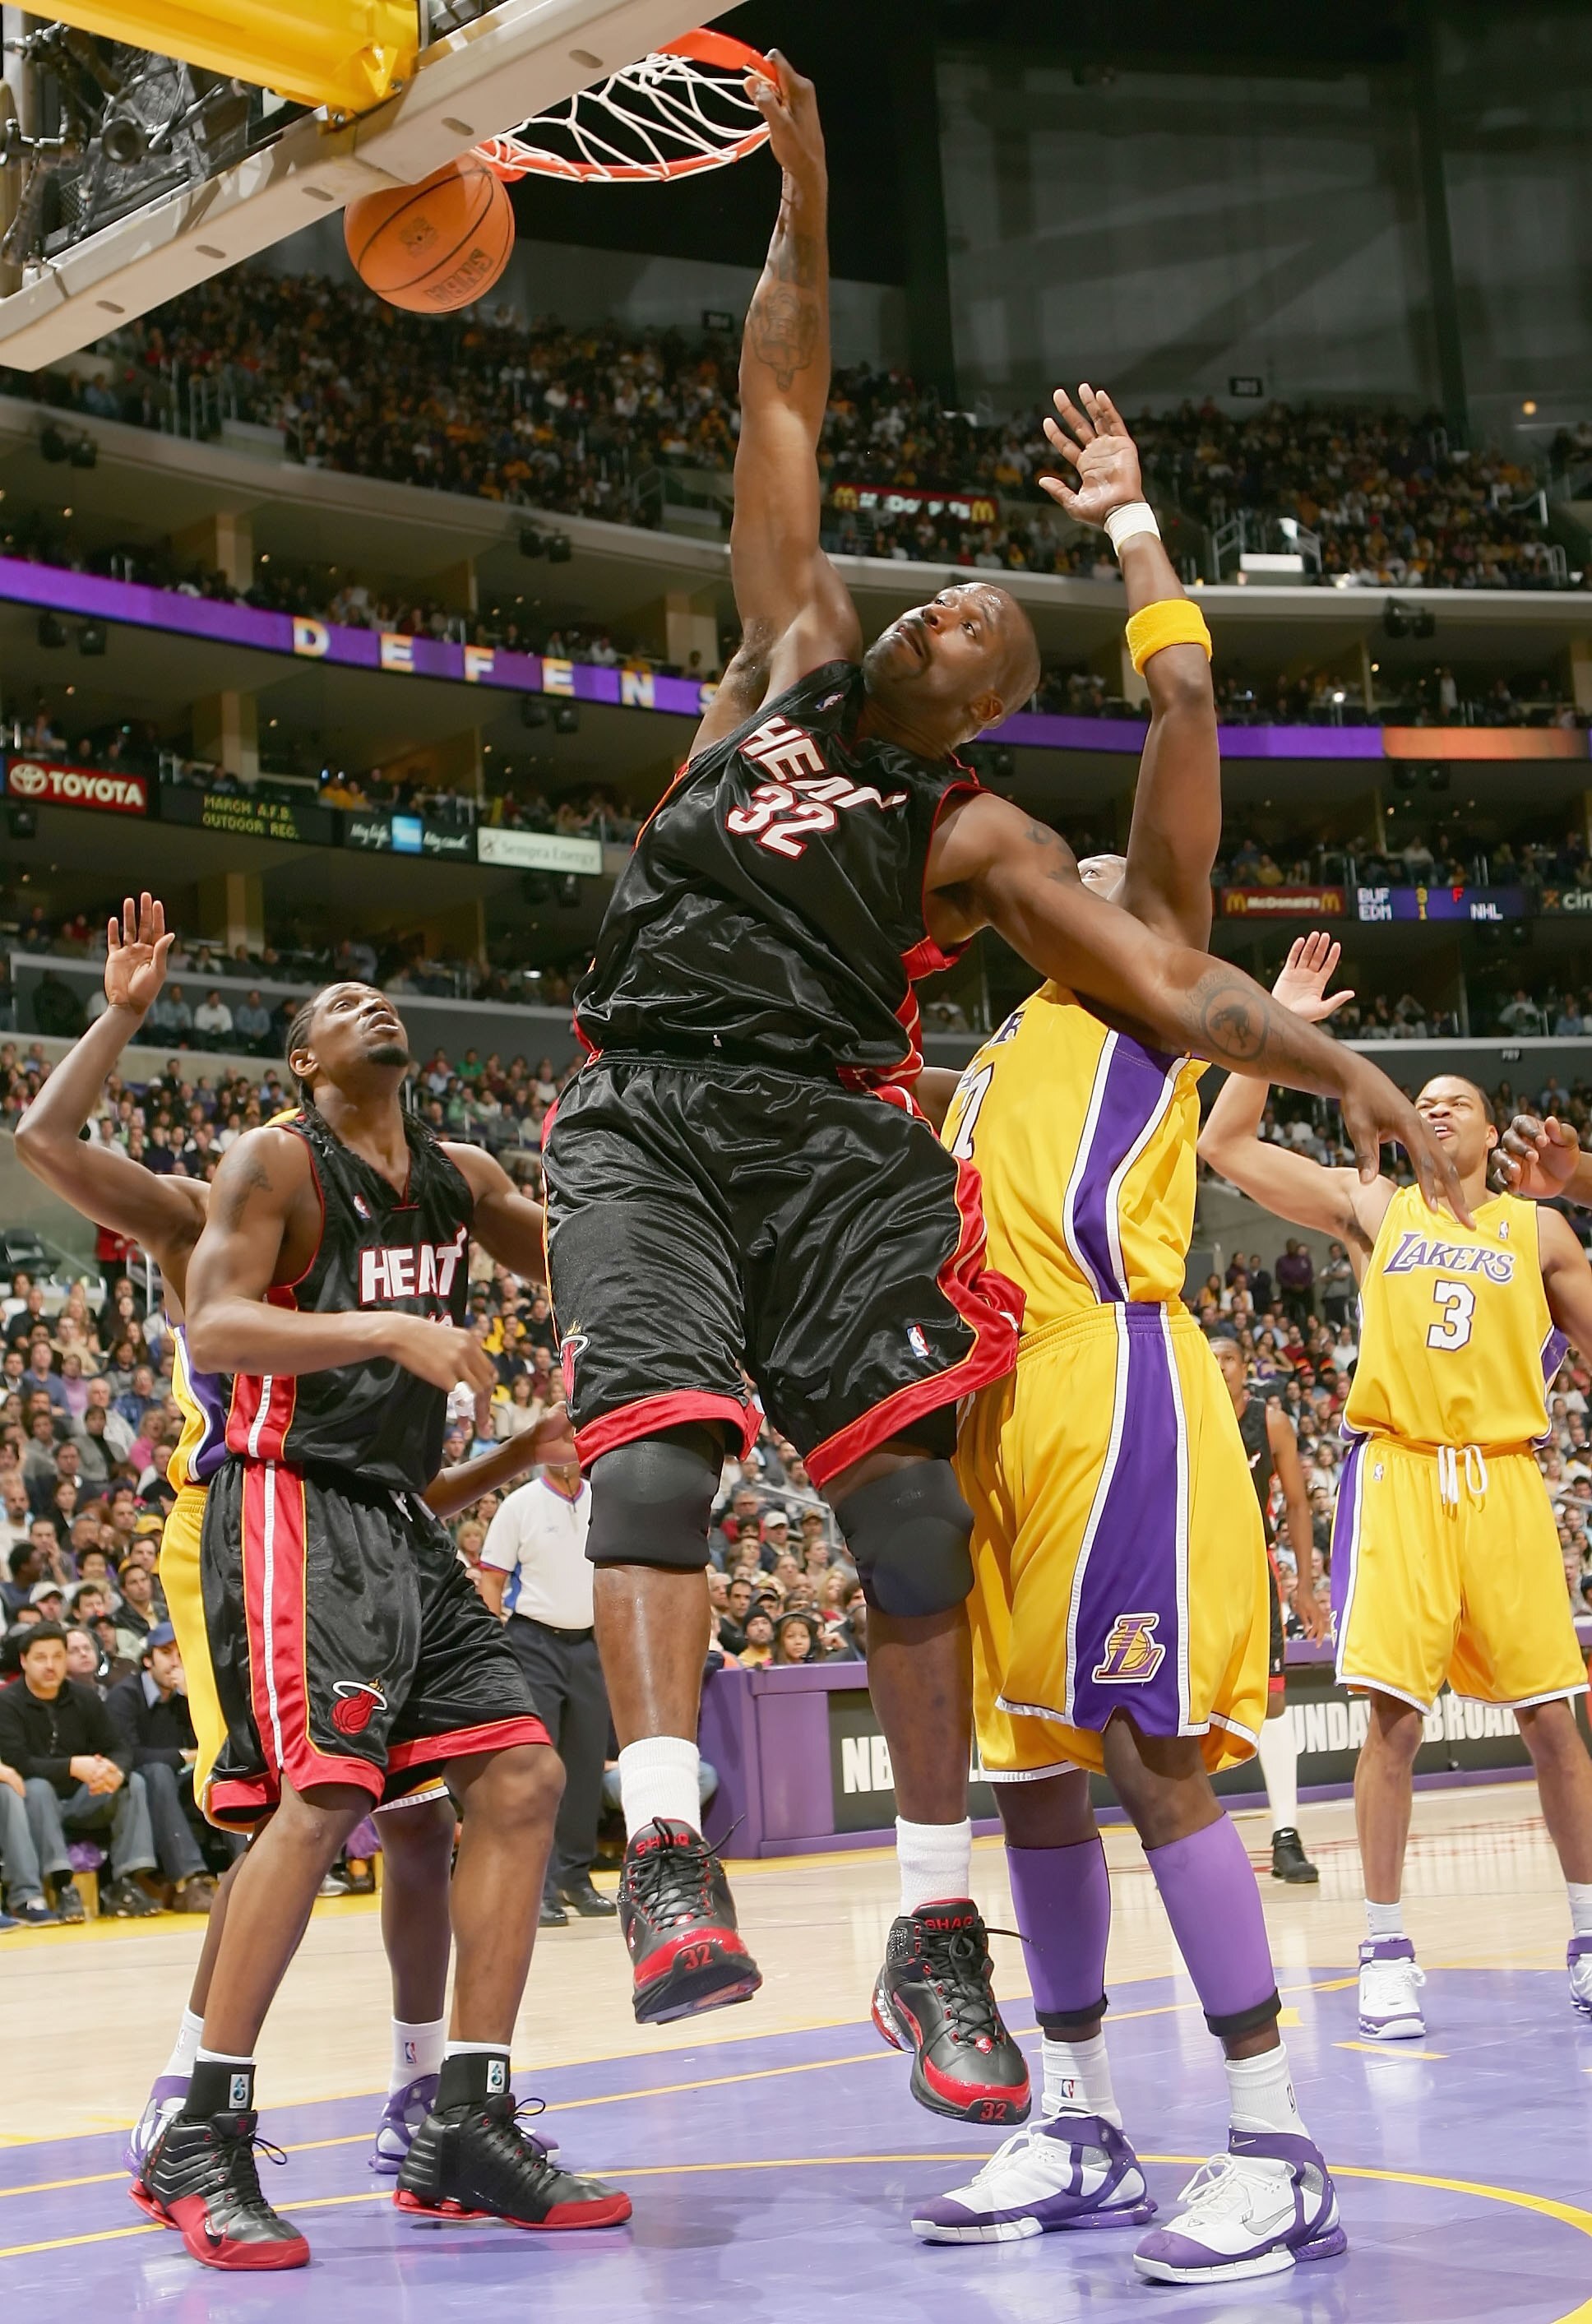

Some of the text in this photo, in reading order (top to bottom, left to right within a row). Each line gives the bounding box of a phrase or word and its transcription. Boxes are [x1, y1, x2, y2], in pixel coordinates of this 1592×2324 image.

[49, 771, 144, 807] TOYOTA
[203, 794, 252, 814] MARCH
[202, 812, 265, 834] OUTDOOR
[725, 782, 838, 861] 32
[1358, 887, 1390, 904] BUF
[1452, 887, 1465, 903] F
[1358, 903, 1503, 921] EDM 1 NHL
[359, 1222, 468, 1305] HEAT
[1383, 1231, 1515, 1285] LAKERS
[1427, 1280, 1476, 1352] 3
[1284, 1699, 1371, 1755] UNDA
[841, 1735, 895, 1794] NB
[923, 1915, 974, 1930] SHAQ
[680, 1943, 714, 1971] 32
[980, 2102, 1007, 2119] 32
